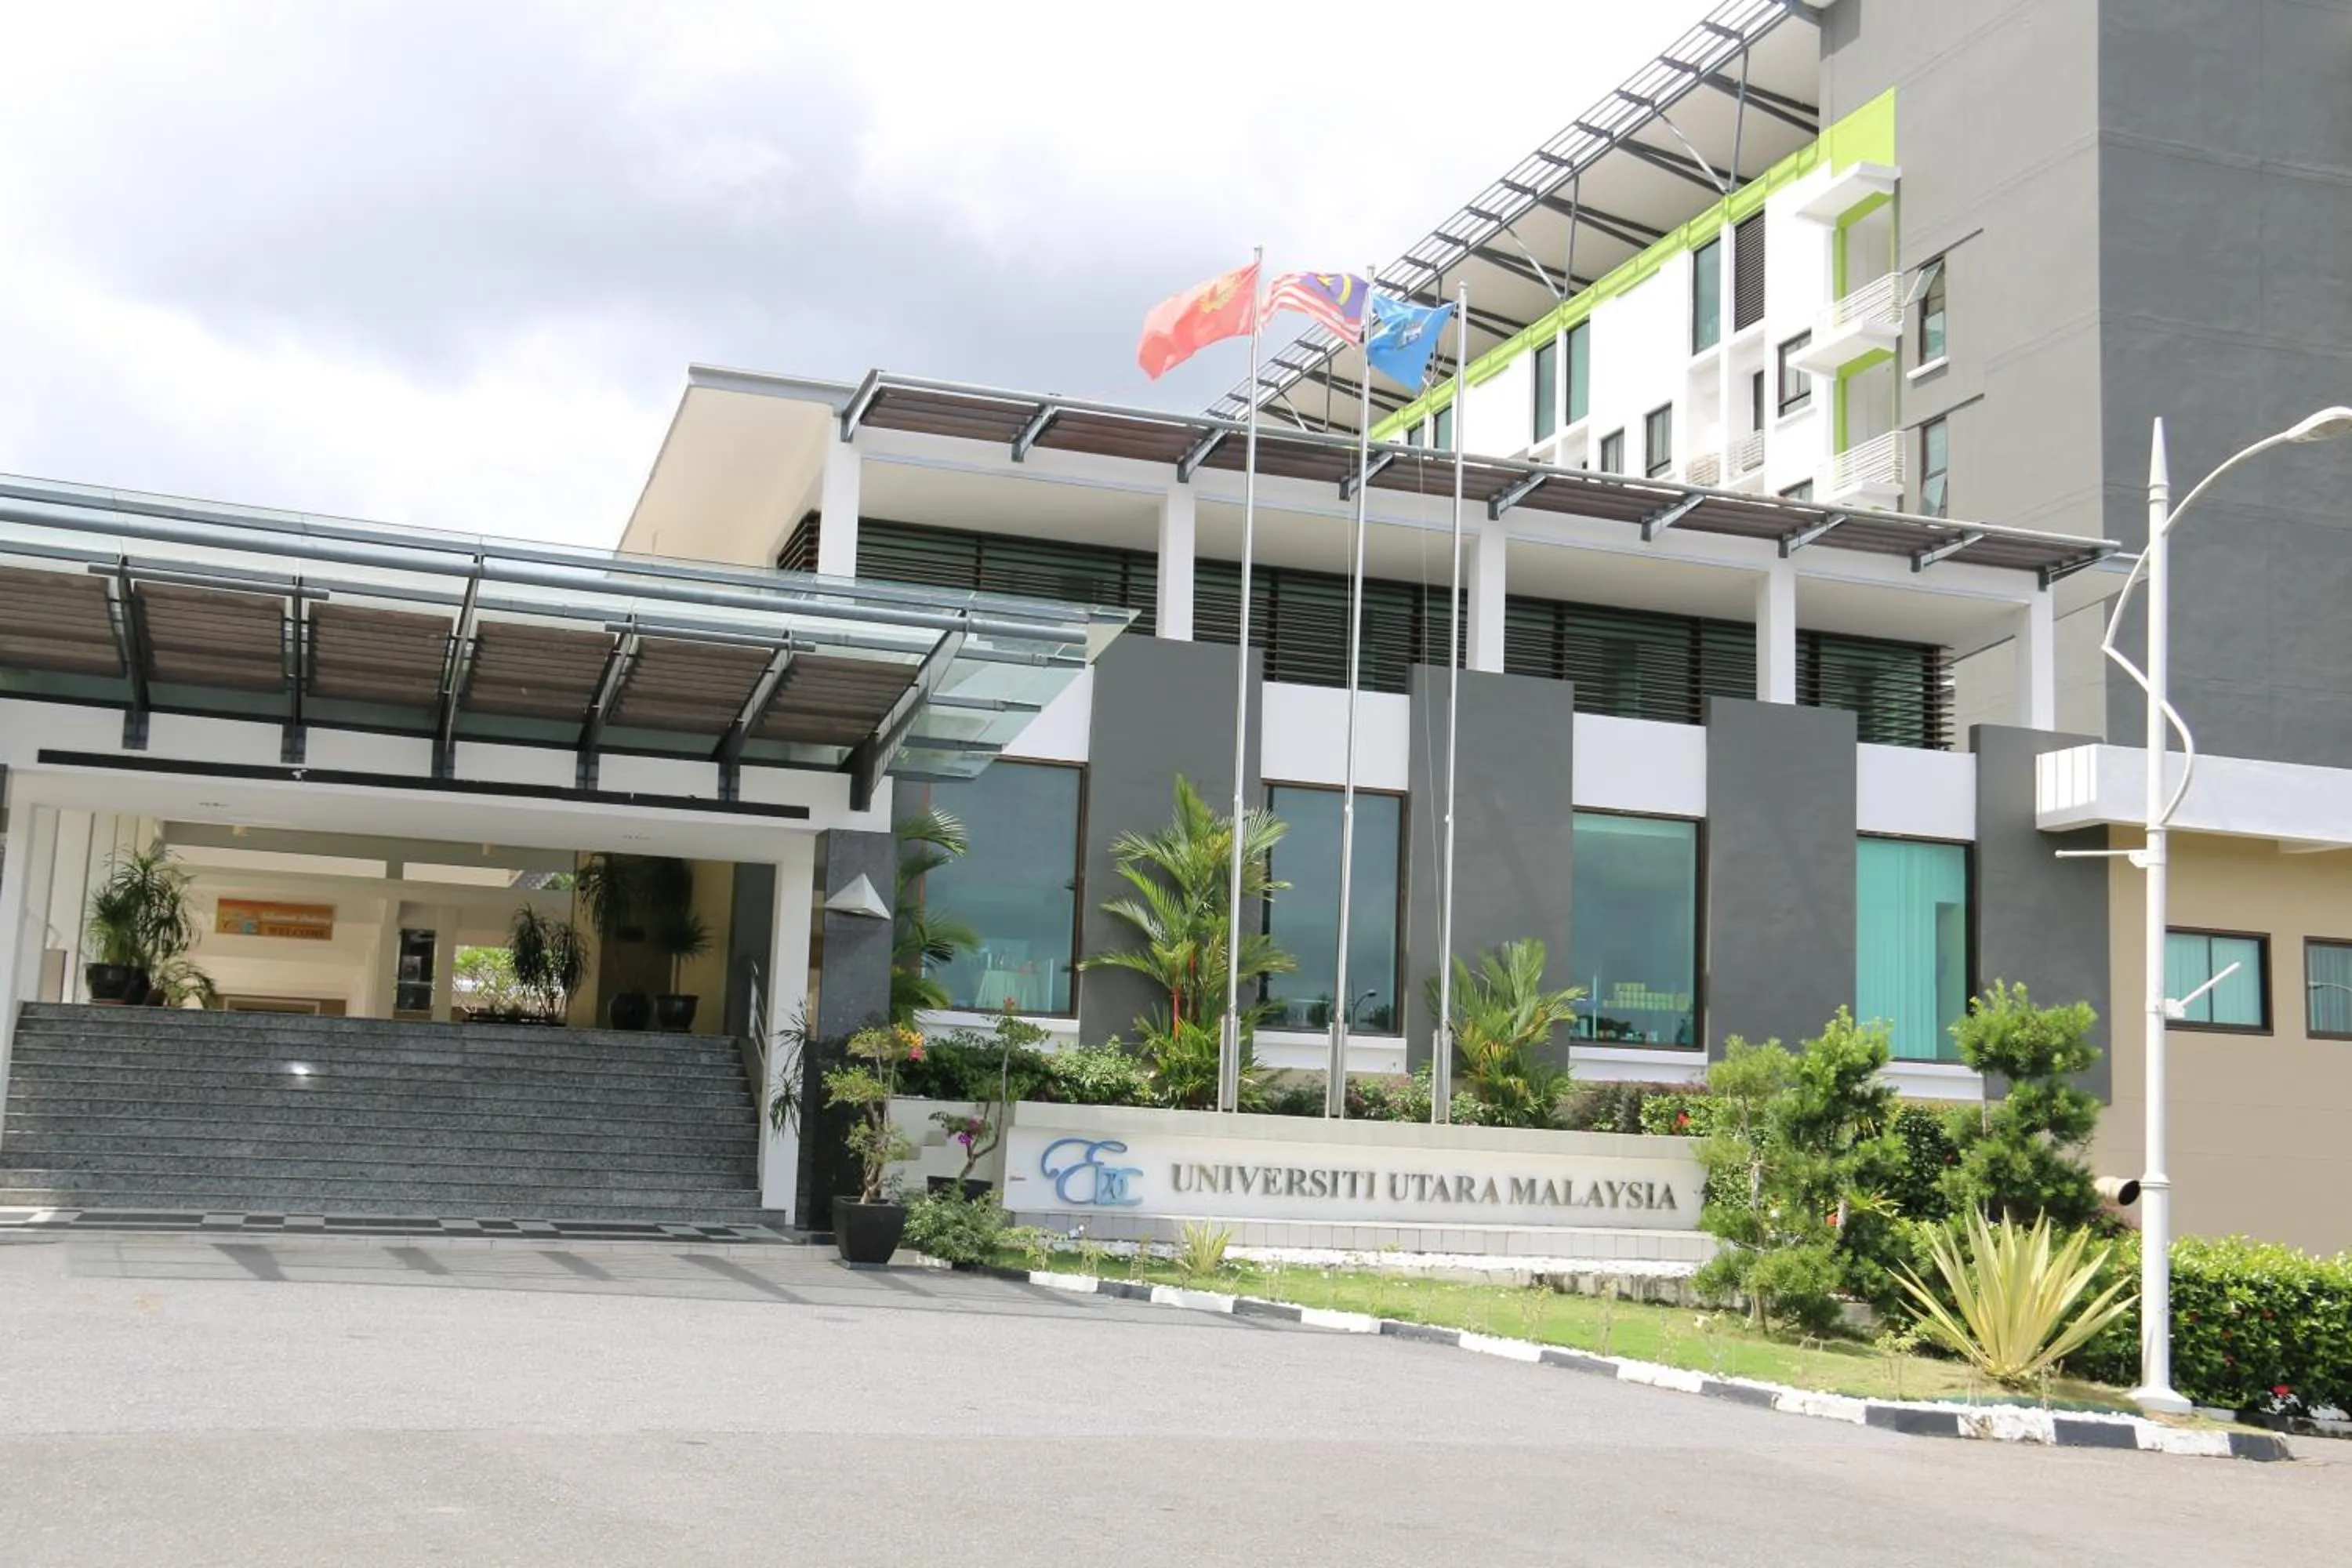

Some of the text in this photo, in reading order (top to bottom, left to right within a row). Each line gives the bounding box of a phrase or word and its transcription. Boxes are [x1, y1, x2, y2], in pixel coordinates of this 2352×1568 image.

[1171, 1163, 1678, 1210] UNIVERSITI UTARA MALAYSIA
